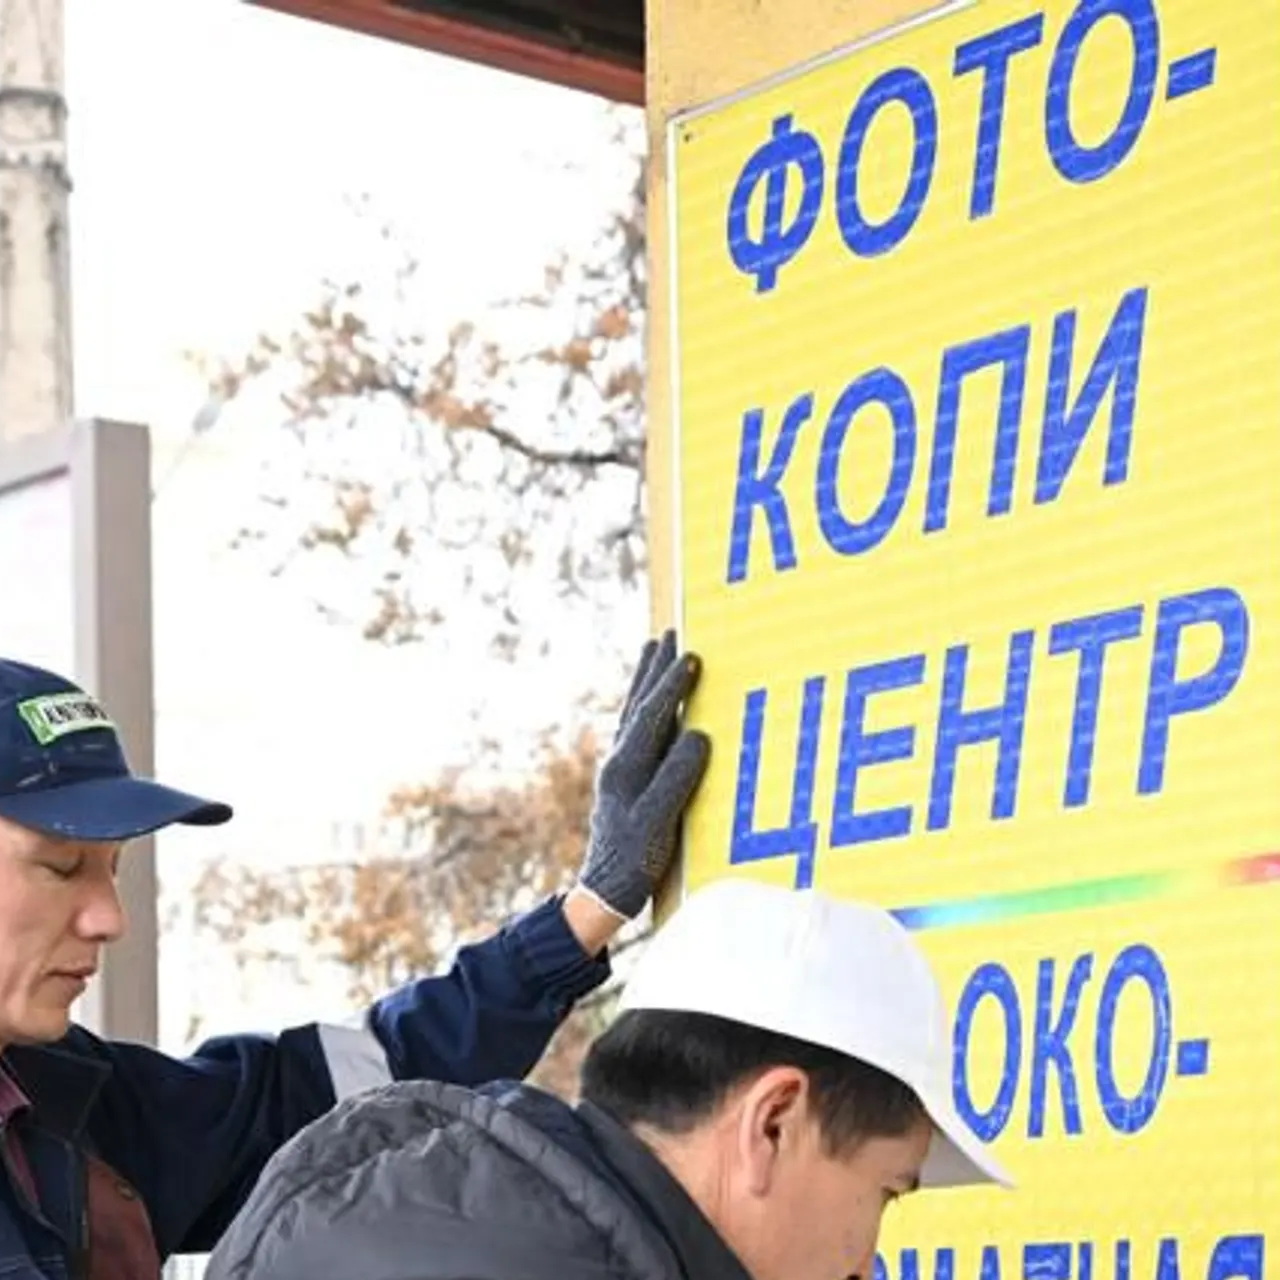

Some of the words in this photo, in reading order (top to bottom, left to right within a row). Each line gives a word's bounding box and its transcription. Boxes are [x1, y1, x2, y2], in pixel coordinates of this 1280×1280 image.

[726, 0, 1218, 293] ФОТО-
[726, 285, 1149, 584] КОПИ
[728, 586, 1251, 890] ЦЕНТР
